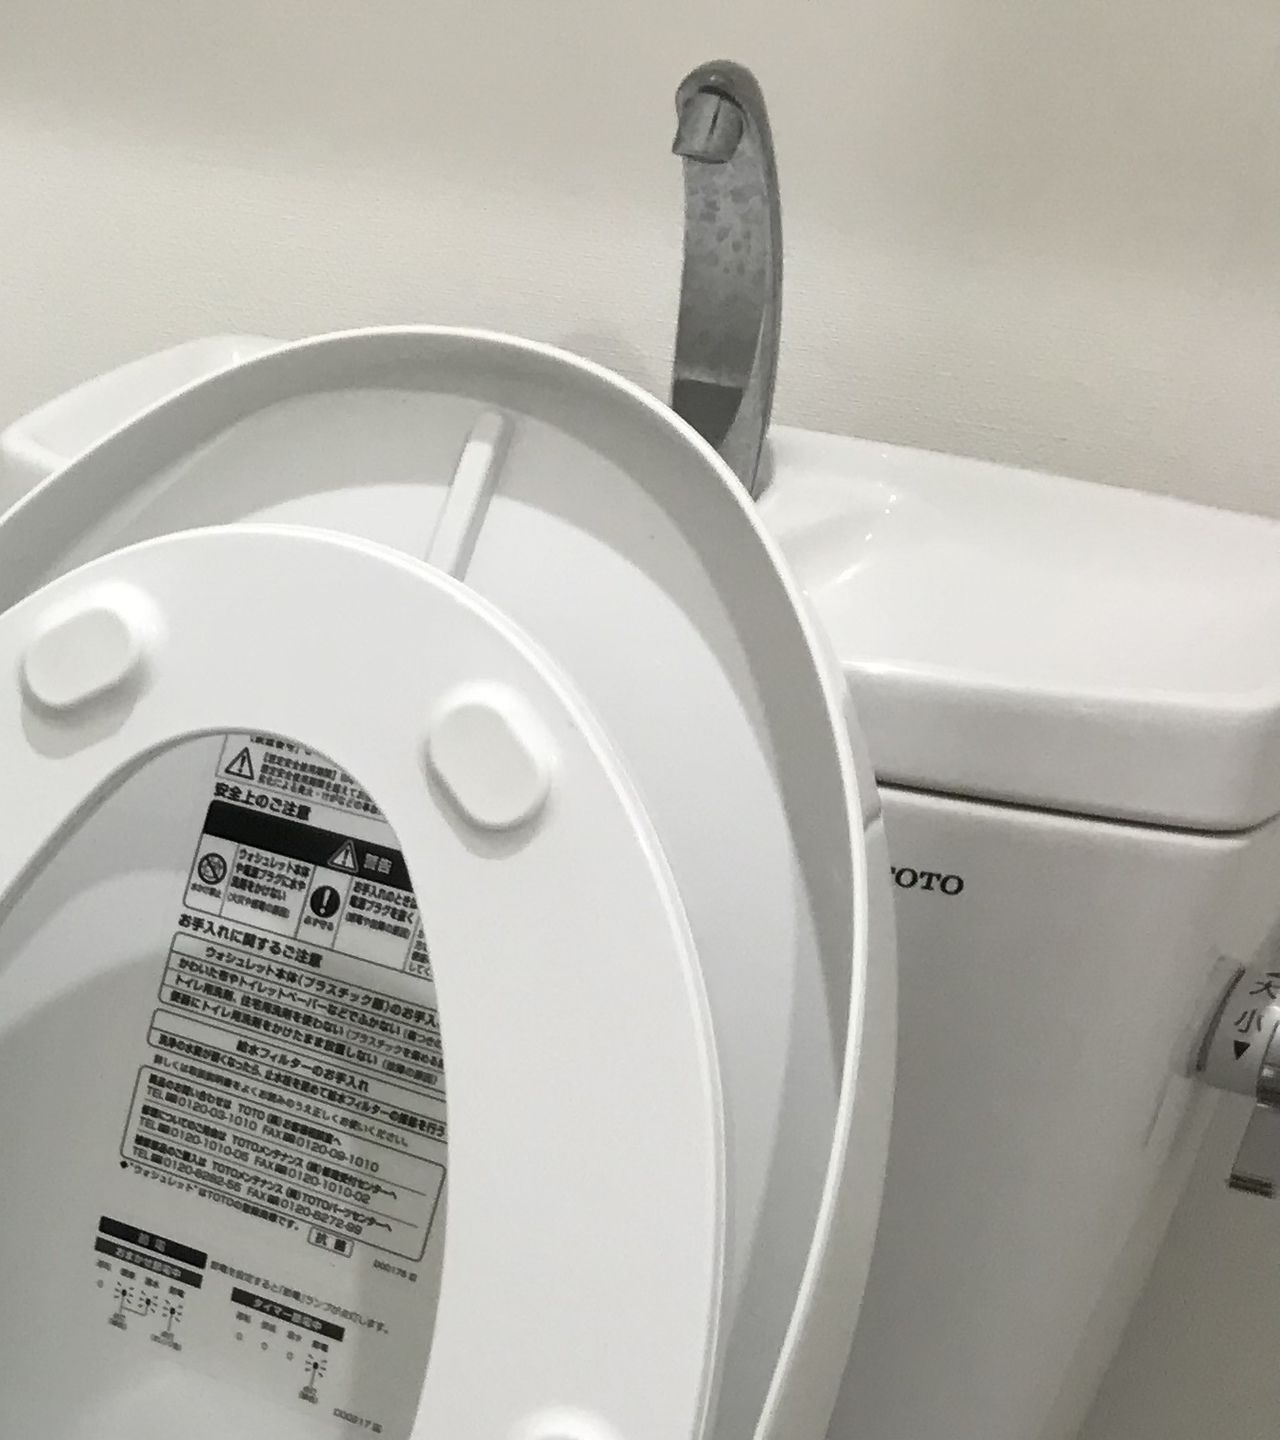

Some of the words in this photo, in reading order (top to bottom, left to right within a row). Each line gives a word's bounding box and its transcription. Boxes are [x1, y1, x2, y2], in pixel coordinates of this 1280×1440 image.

[213, 780, 313, 821] 安全上のご注意
[891, 867, 964, 895] OTO
[177, 912, 323, 968] お手入れに関するご注意
[204, 945, 442, 1029] ウォシュレット本体(プラスチック部)のお手入
[1233, 1008, 1263, 1033] 小
[235, 1039, 371, 1092] 給水フィルターのお手入れ
